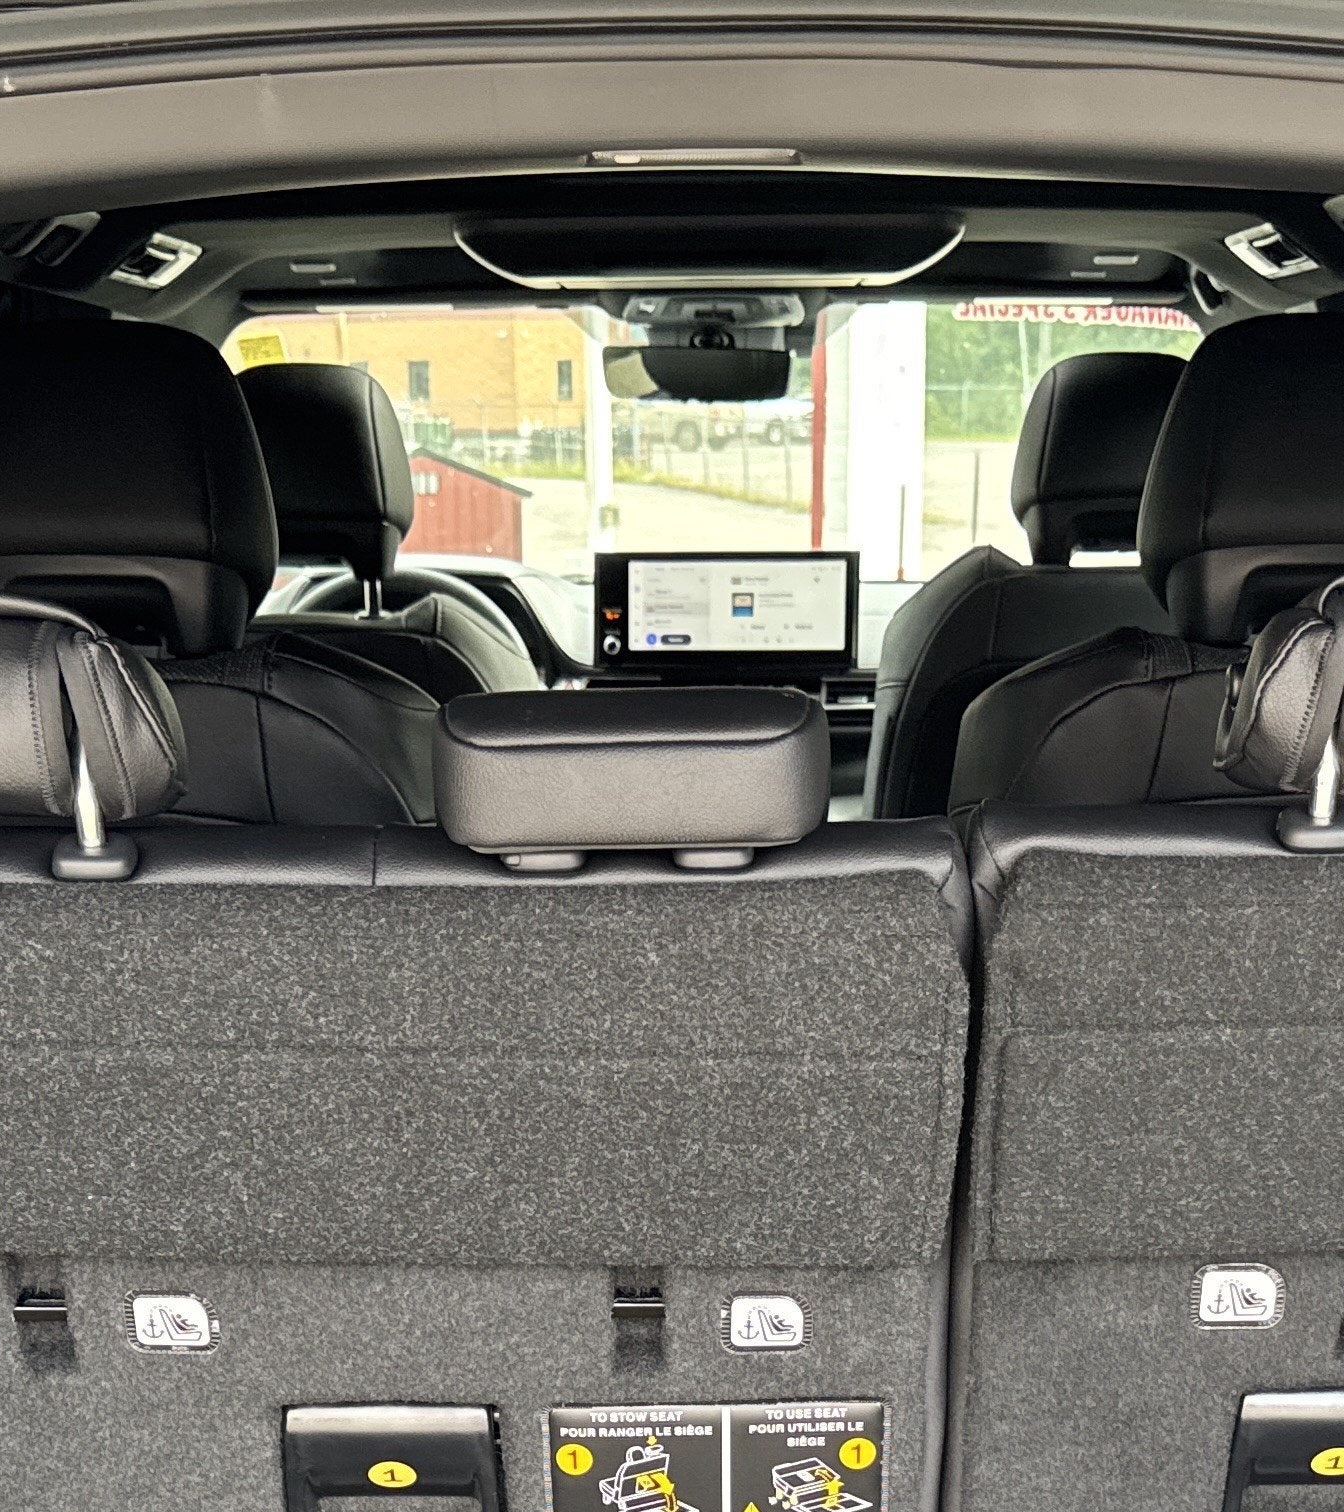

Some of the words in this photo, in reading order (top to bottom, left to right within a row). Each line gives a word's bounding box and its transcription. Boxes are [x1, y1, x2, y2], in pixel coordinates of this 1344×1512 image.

[590, 1411, 608, 1423] TO
[609, 1411, 648, 1423] STOW
[649, 1410, 684, 1422] SEAT
[765, 1409, 784, 1421] TO
[785, 1408, 812, 1420] USE
[813, 1407, 848, 1419] SEAT
[560, 1427, 596, 1438] POUR
[598, 1426, 652, 1437] RANGER
[656, 1426, 672, 1437] LE
[748, 1423, 785, 1434] POUR
[787, 1422, 845, 1433] UTILISER
[847, 1421, 865, 1432] LE
[567, 1449, 578, 1470] 1
[851, 1443, 861, 1464] 1
[1325, 1456, 1344, 1470] 1
[383, 1468, 403, 1483] 1
